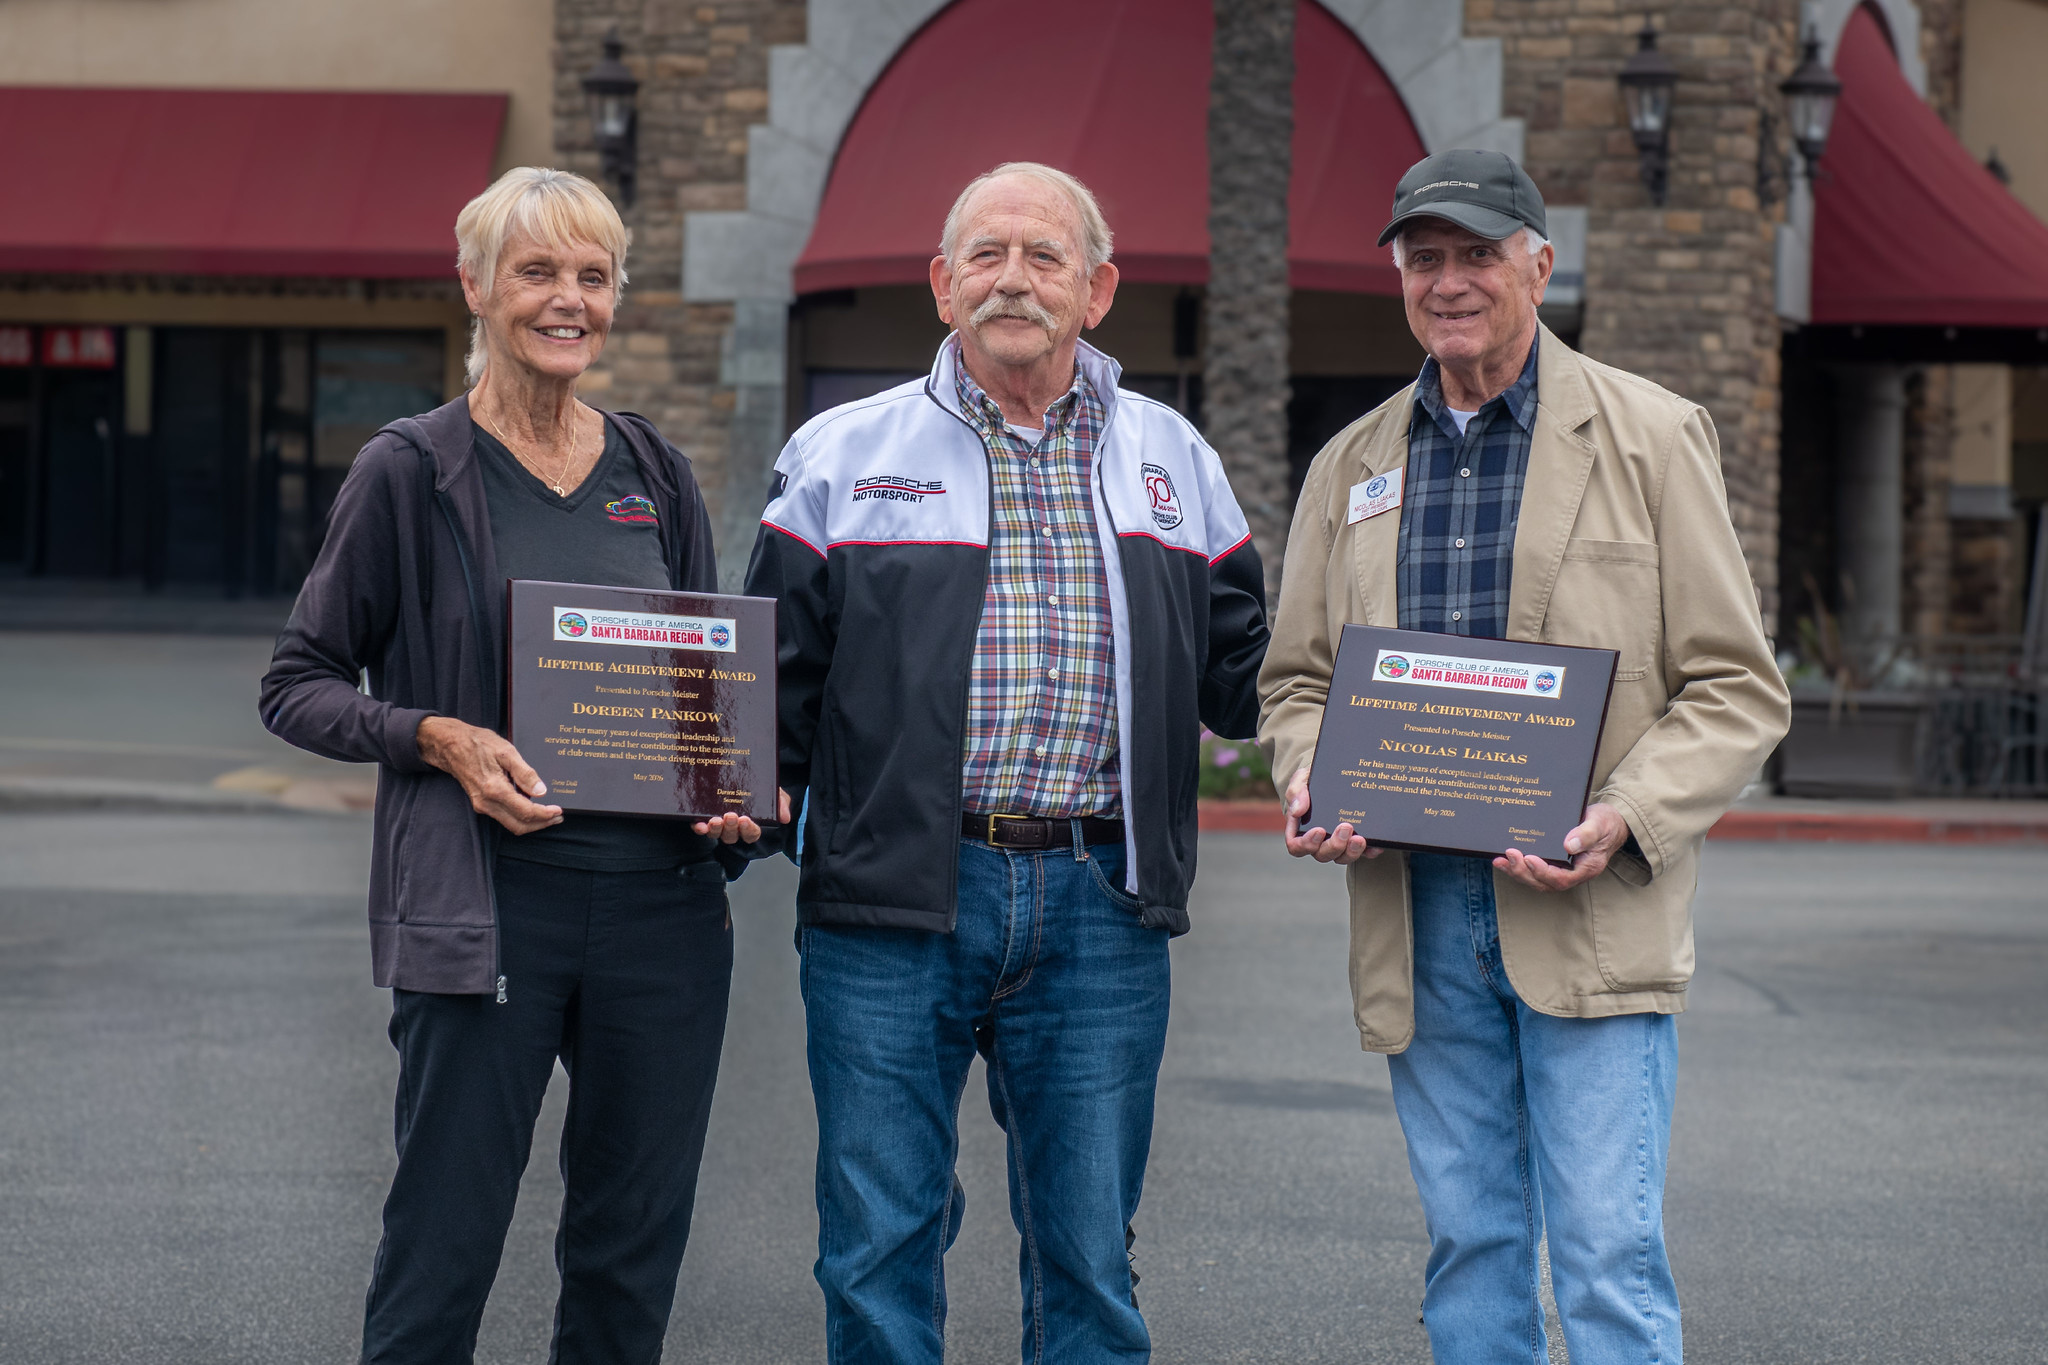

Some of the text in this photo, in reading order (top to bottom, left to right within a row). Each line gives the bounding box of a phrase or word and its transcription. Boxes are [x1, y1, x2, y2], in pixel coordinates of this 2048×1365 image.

[1414, 180, 1479, 195] PORSCHE
[855, 476, 942, 490] PORSCHE
[852, 489, 925, 503] MOTORSPORT
[1146, 477, 1171, 508] 60
[592, 616, 629, 625] PORSCHE
[632, 619, 652, 627] CLUB
[668, 621, 703, 630] AMERICA
[591, 626, 703, 645] SANTA BARBARA REGION
[538, 657, 756, 682] LIFETIME ACHIEVEMENT AWARD
[1414, 659, 1453, 668] PORSCHE
[1455, 662, 1477, 671] CLUB
[1479, 664, 1491, 672] OF
[1492, 666, 1529, 676] AMERICA
[1412, 668, 1528, 690] SANTA BARBARA REGION
[595, 685, 631, 695] Presented
[642, 688, 670, 697] Porsche
[672, 690, 699, 699] Meister
[572, 702, 723, 722] DOREEN PANKOW
[1349, 695, 1576, 727] LIFETIME ACHIEVEMENT AWARD
[559, 724, 572, 732] For
[573, 725, 586, 733] her
[587, 728, 608, 737] many
[630, 729, 639, 737] of
[639, 731, 680, 740] exceptional
[682, 732, 720, 744] leadership
[1403, 723, 1441, 734] Presented
[1451, 728, 1481, 738] Porsche
[1482, 731, 1511, 741] Meister
[581, 738, 592, 746] the
[611, 740, 625, 748] and
[627, 740, 639, 748] her
[641, 742, 689, 751] contributions
[699, 745, 711, 753] the
[712, 747, 750, 756] enjoyment
[1379, 739, 1528, 764] NICOLAS LIAKAS
[557, 748, 566, 756] of
[567, 748, 583, 756] club
[625, 752, 637, 760] the
[638, 753, 667, 761] Porsche
[668, 755, 695, 765] driving
[633, 773, 647, 782] May
[1358, 758, 1372, 767] For
[1372, 760, 1384, 768] his
[1385, 763, 1407, 773] many
[1407, 765, 1428, 773] years
[1429, 766, 1439, 774] of
[1439, 769, 1482, 778] exceptional
[1483, 771, 1523, 784] leadership
[1341, 769, 1367, 778] service
[1368, 771, 1376, 779] to
[1378, 772, 1390, 780] the
[1391, 773, 1408, 781] club
[1425, 776, 1437, 785] his
[1437, 779, 1487, 790] contributions
[1498, 784, 1511, 793] the
[1511, 787, 1552, 797] enjoyment
[1351, 780, 1536, 806] of club events and the Porsche driving experience.
[1424, 807, 1456, 817] May 2026
